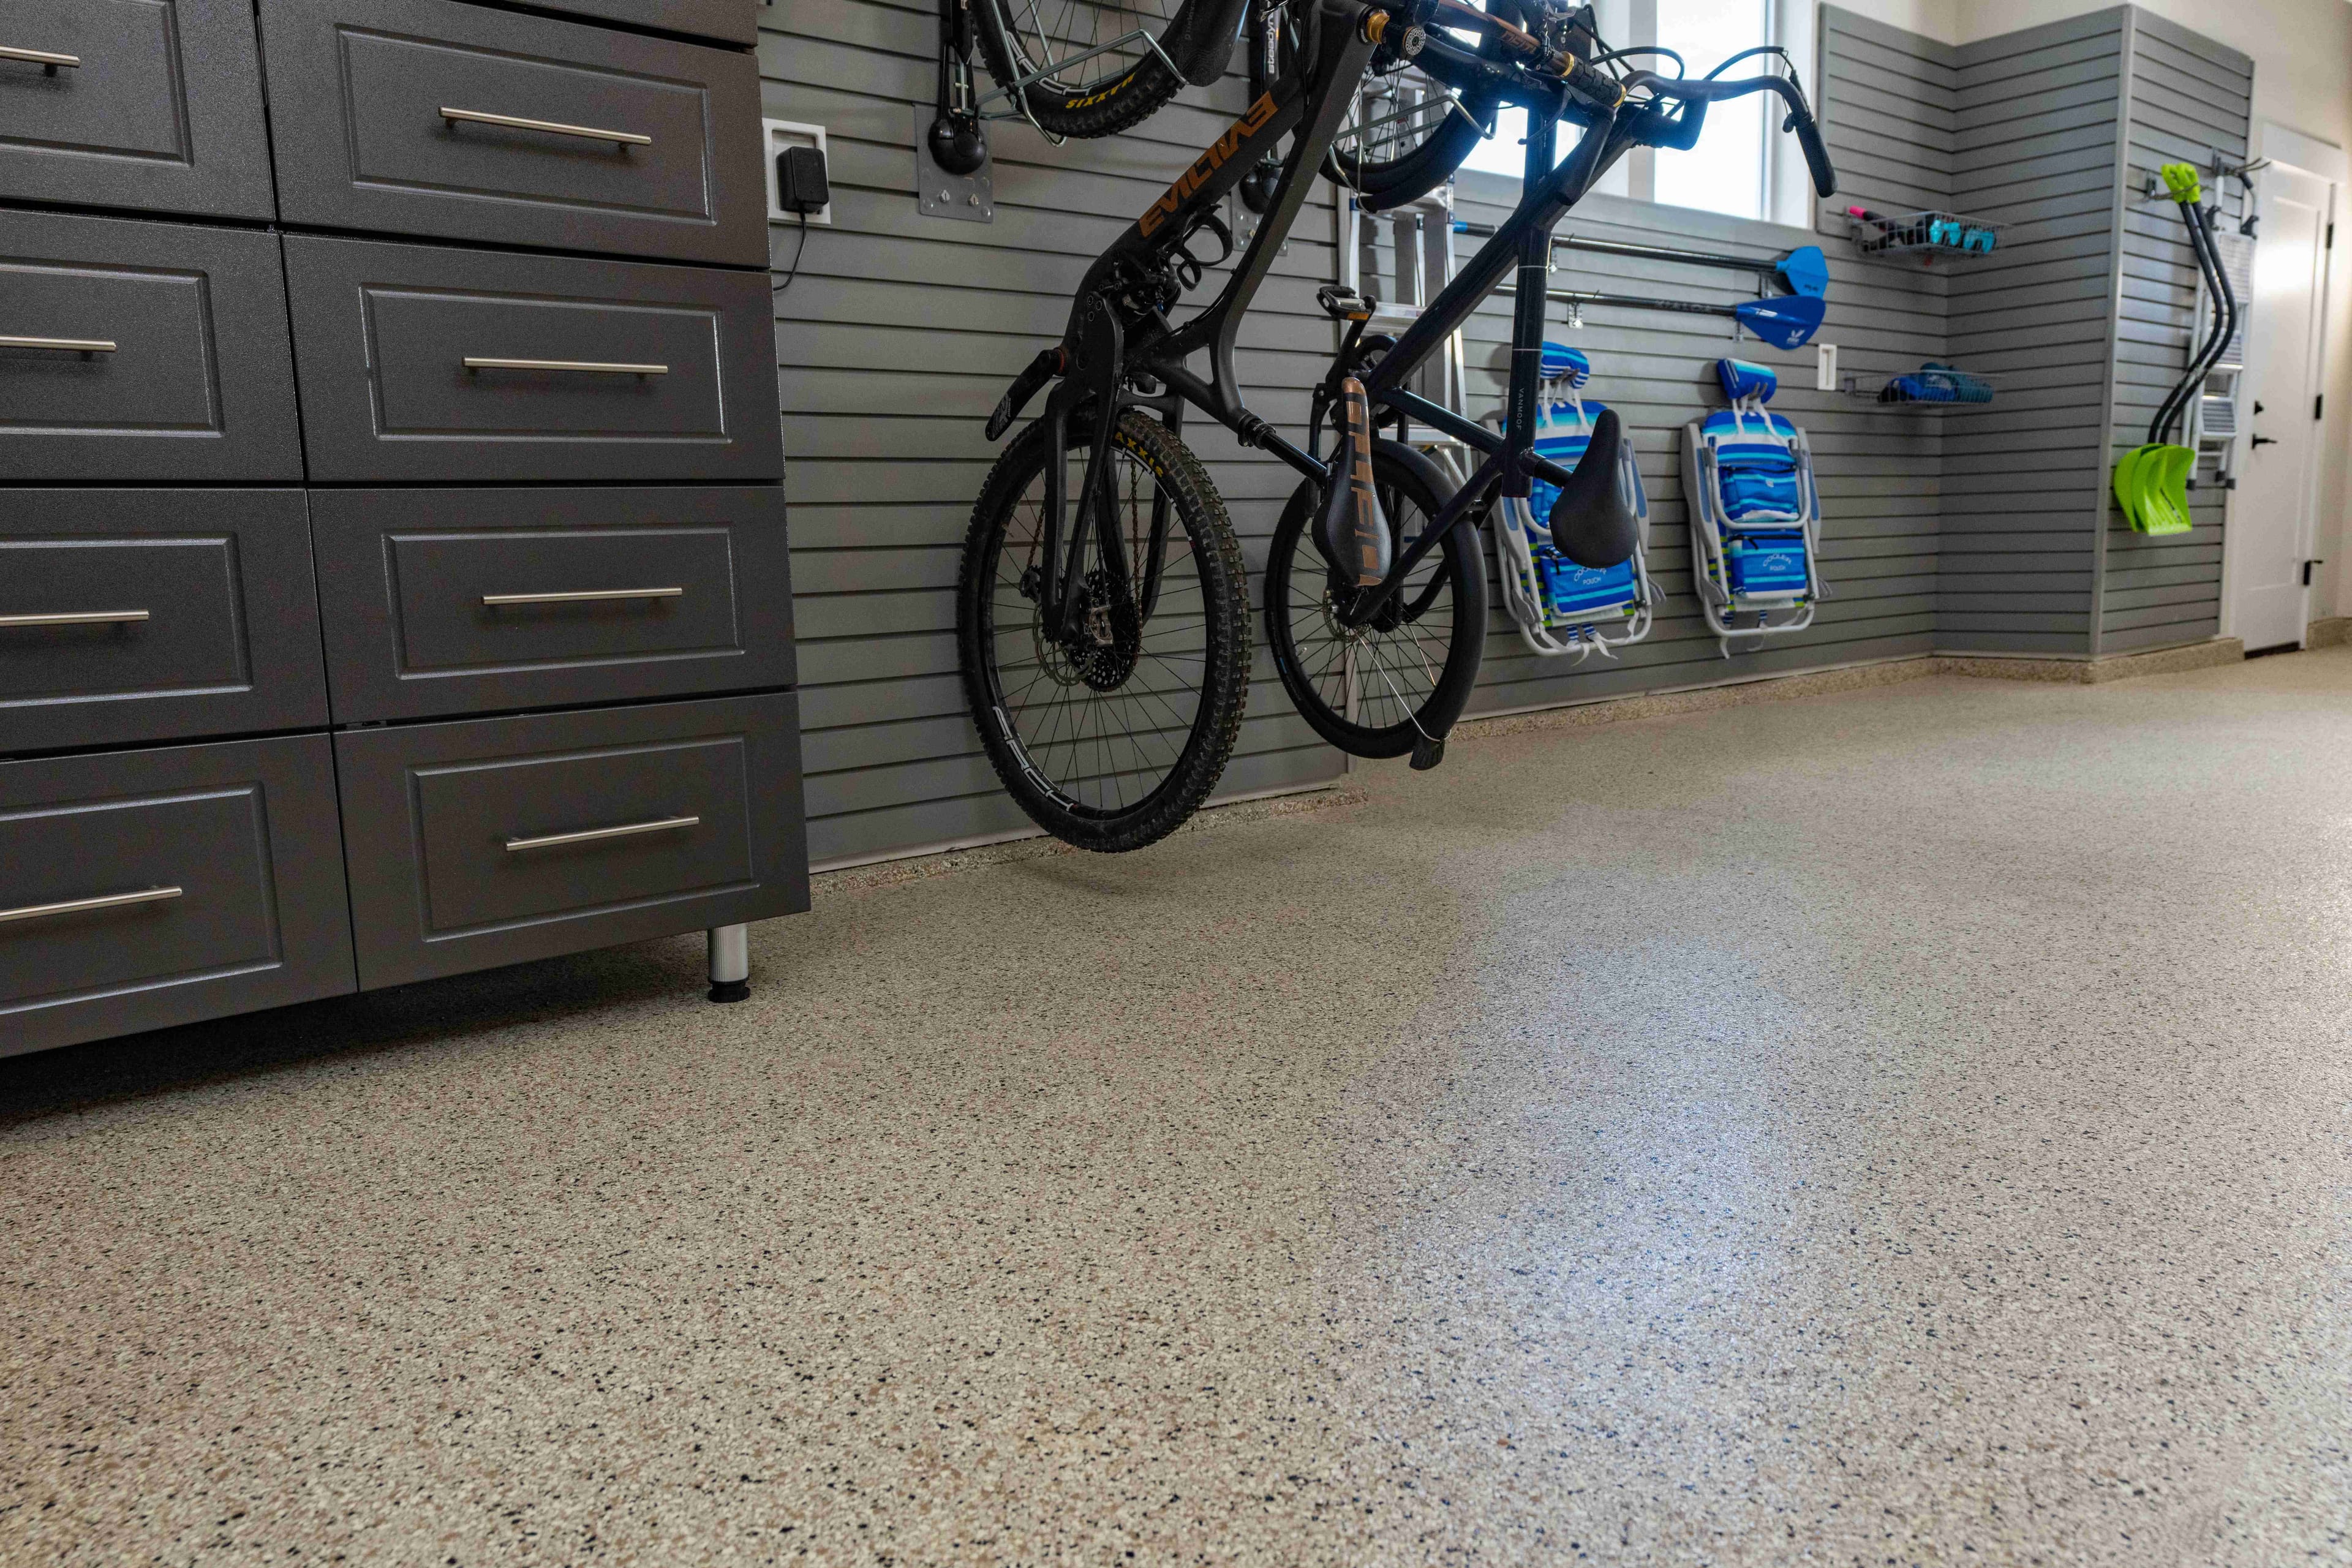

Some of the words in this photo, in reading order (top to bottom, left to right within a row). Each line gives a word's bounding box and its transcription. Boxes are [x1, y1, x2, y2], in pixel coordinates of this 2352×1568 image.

[1065, 72, 1136, 109] MAXXIS
[1516, 388, 1525, 431] VANMOOF
[1114, 431, 1164, 478] AXXIS
[1763, 553, 1792, 567] COOLER
[992, 706, 1074, 812] ARCH
